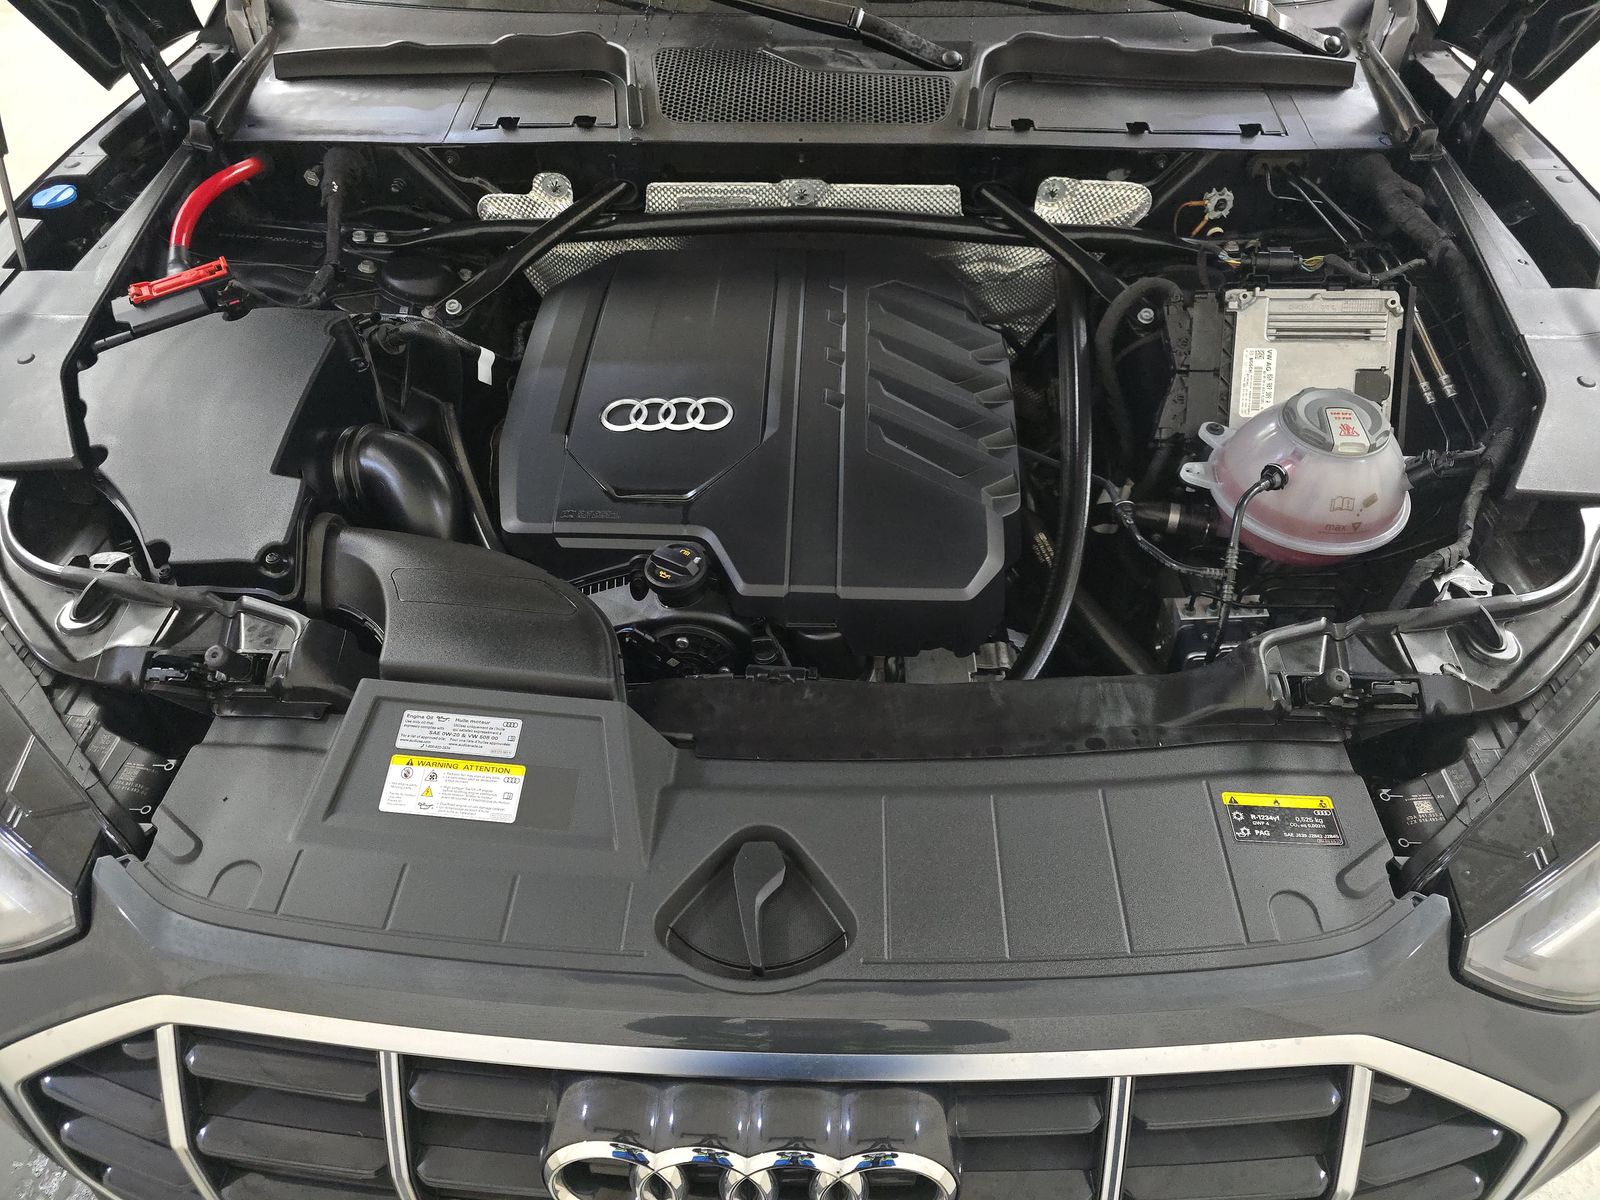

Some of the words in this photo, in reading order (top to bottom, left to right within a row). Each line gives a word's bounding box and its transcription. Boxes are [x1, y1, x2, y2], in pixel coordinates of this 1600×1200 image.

[1266, 349, 1273, 361] VW
[1265, 361, 1272, 372] AG
[1324, 523, 1346, 532] max
[417, 759, 459, 770] WARNING
[462, 763, 511, 775] ATTENTION
[1250, 813, 1280, 823] R-1234yf
[1254, 829, 1271, 837] PAG
